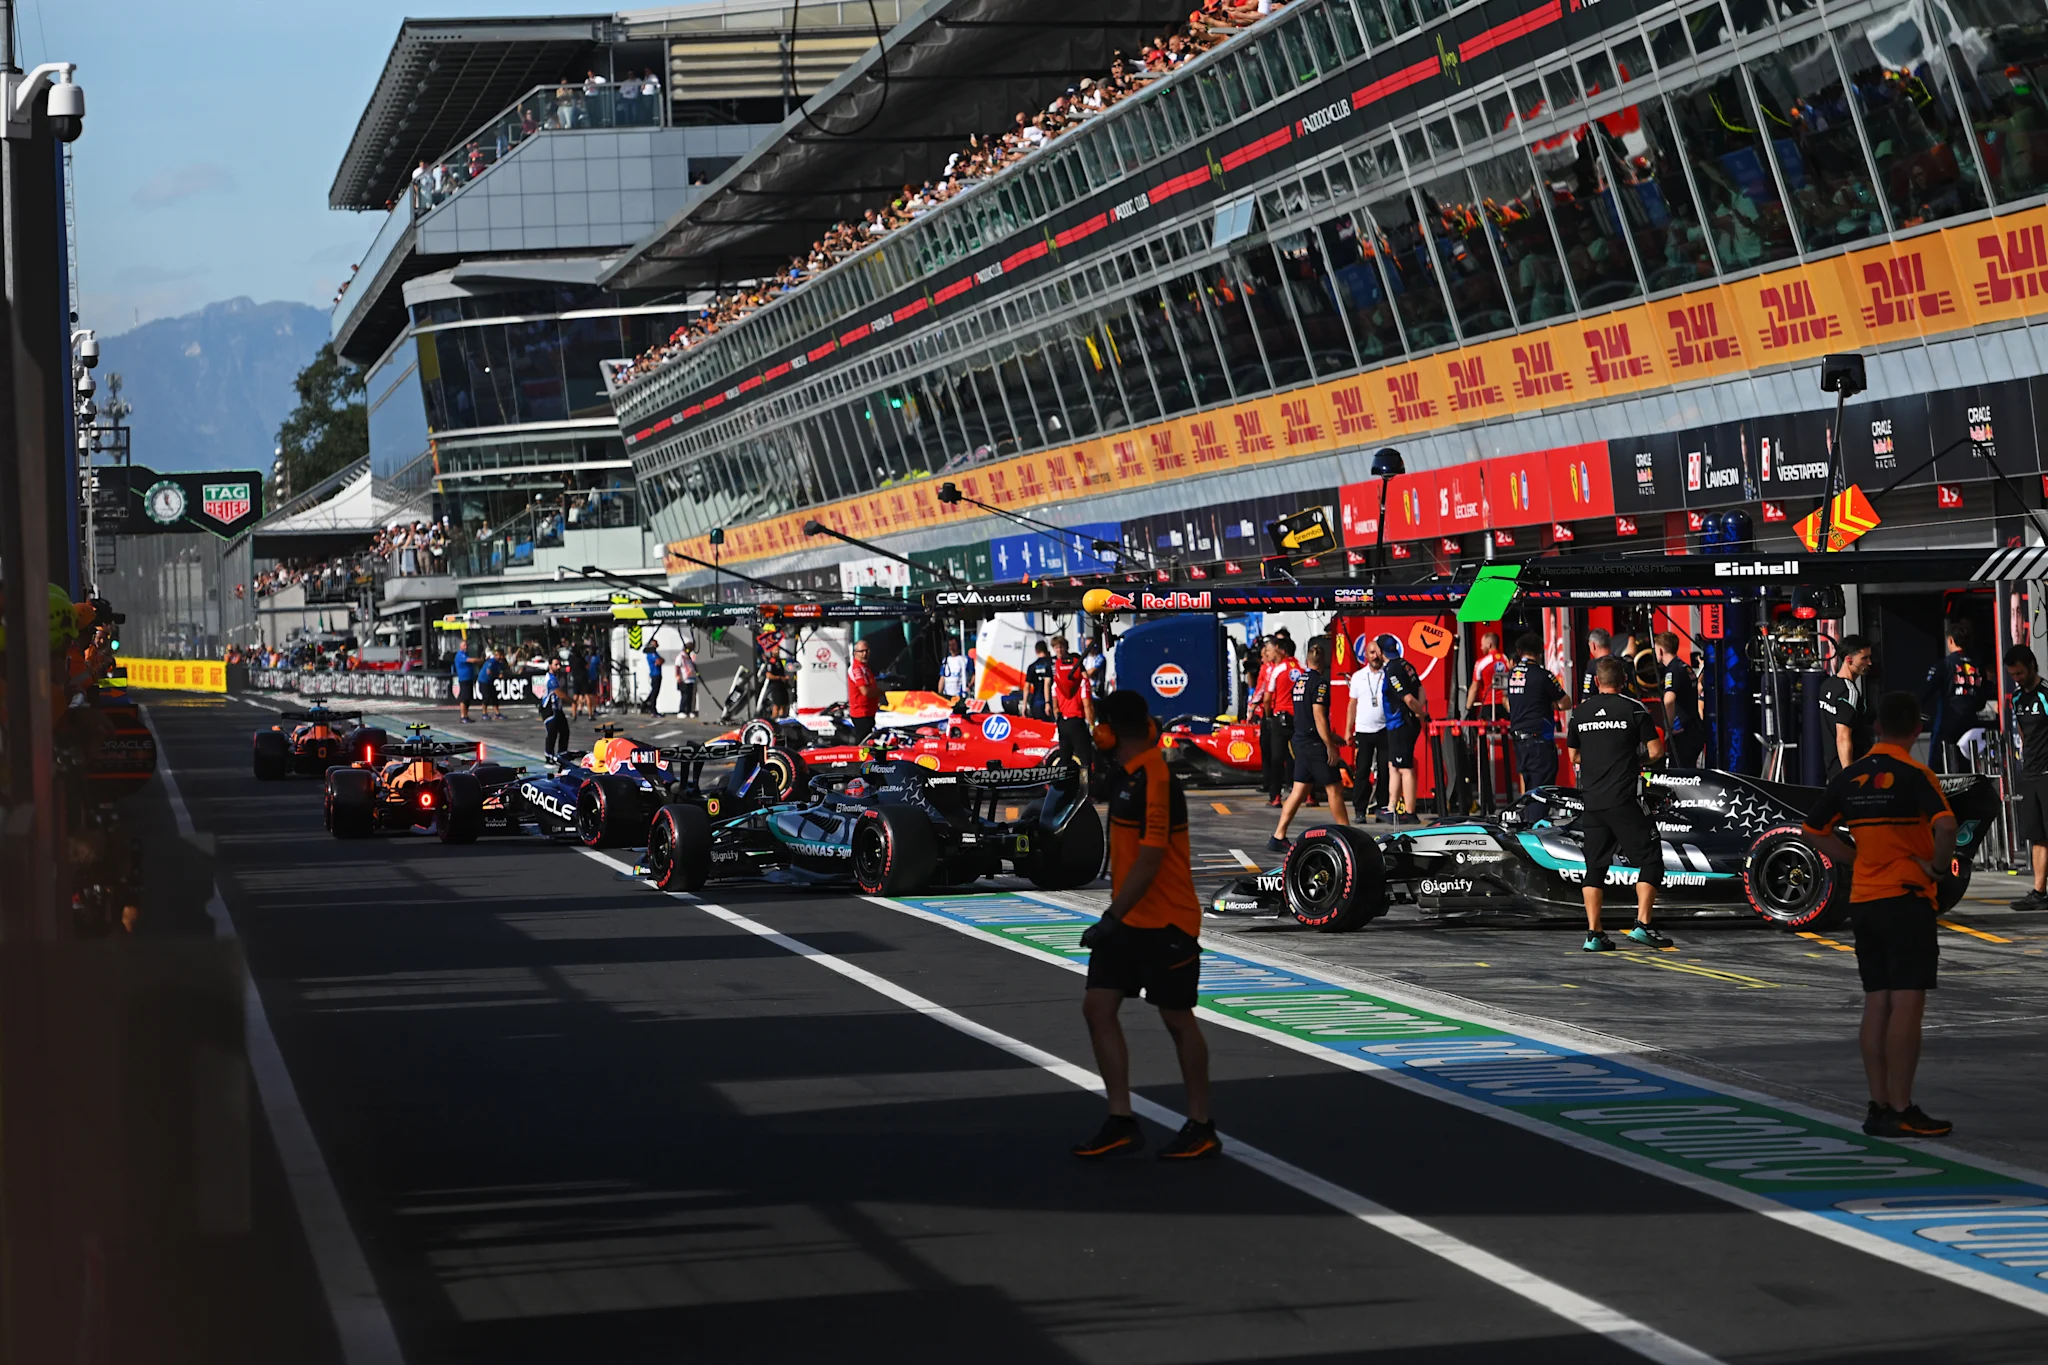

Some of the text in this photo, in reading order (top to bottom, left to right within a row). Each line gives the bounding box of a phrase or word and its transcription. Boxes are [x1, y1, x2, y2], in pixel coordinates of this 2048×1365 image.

[1705, 468, 1740, 489] LAWSON
[1777, 462, 1829, 482] VERSTAPPEN
[206, 487, 246, 500] TAG
[206, 501, 249, 524] HEUER
[1766, 503, 1783, 518] 21
[1295, 527, 1323, 543] brembo
[1556, 525, 1572, 538] 24
[1540, 565, 1604, 575] Mercedes-AMG
[1605, 565, 1650, 574] PETRONAS
[1714, 561, 1799, 576] Einhell
[936, 592, 1031, 604] CEVA LOGISTICS
[1142, 592, 1211, 609] Red Bull
[1422, 624, 1444, 638] BRAKES
[1154, 676, 1185, 686] Gulf
[986, 716, 1008, 740] hp
[1578, 720, 1627, 732] PETRONAS
[660, 746, 753, 759] ORACLE
[870, 764, 896, 774] Microsoft
[972, 766, 1067, 783] CROWDSTRIKE
[1652, 774, 1702, 786] Microsoft
[520, 782, 577, 821] ORACLE
[1680, 799, 1717, 808] SOLERA
[1502, 811, 1516, 821] nu
[1305, 829, 1327, 838] PIRELLI
[786, 842, 834, 857] PETRONAS
[1467, 854, 1500, 863] Snapdragon
[1257, 877, 1283, 891] IWC
[1559, 867, 1639, 886] PETONA
[1661, 872, 1706, 888] Syntium
[1421, 879, 1473, 894] Signify
[1743, 871, 1762, 913] ZERO
[1226, 900, 1258, 910] Microsoft
[1297, 907, 1338, 926] P ZERO
[1559, 1105, 1947, 1181] aramco
